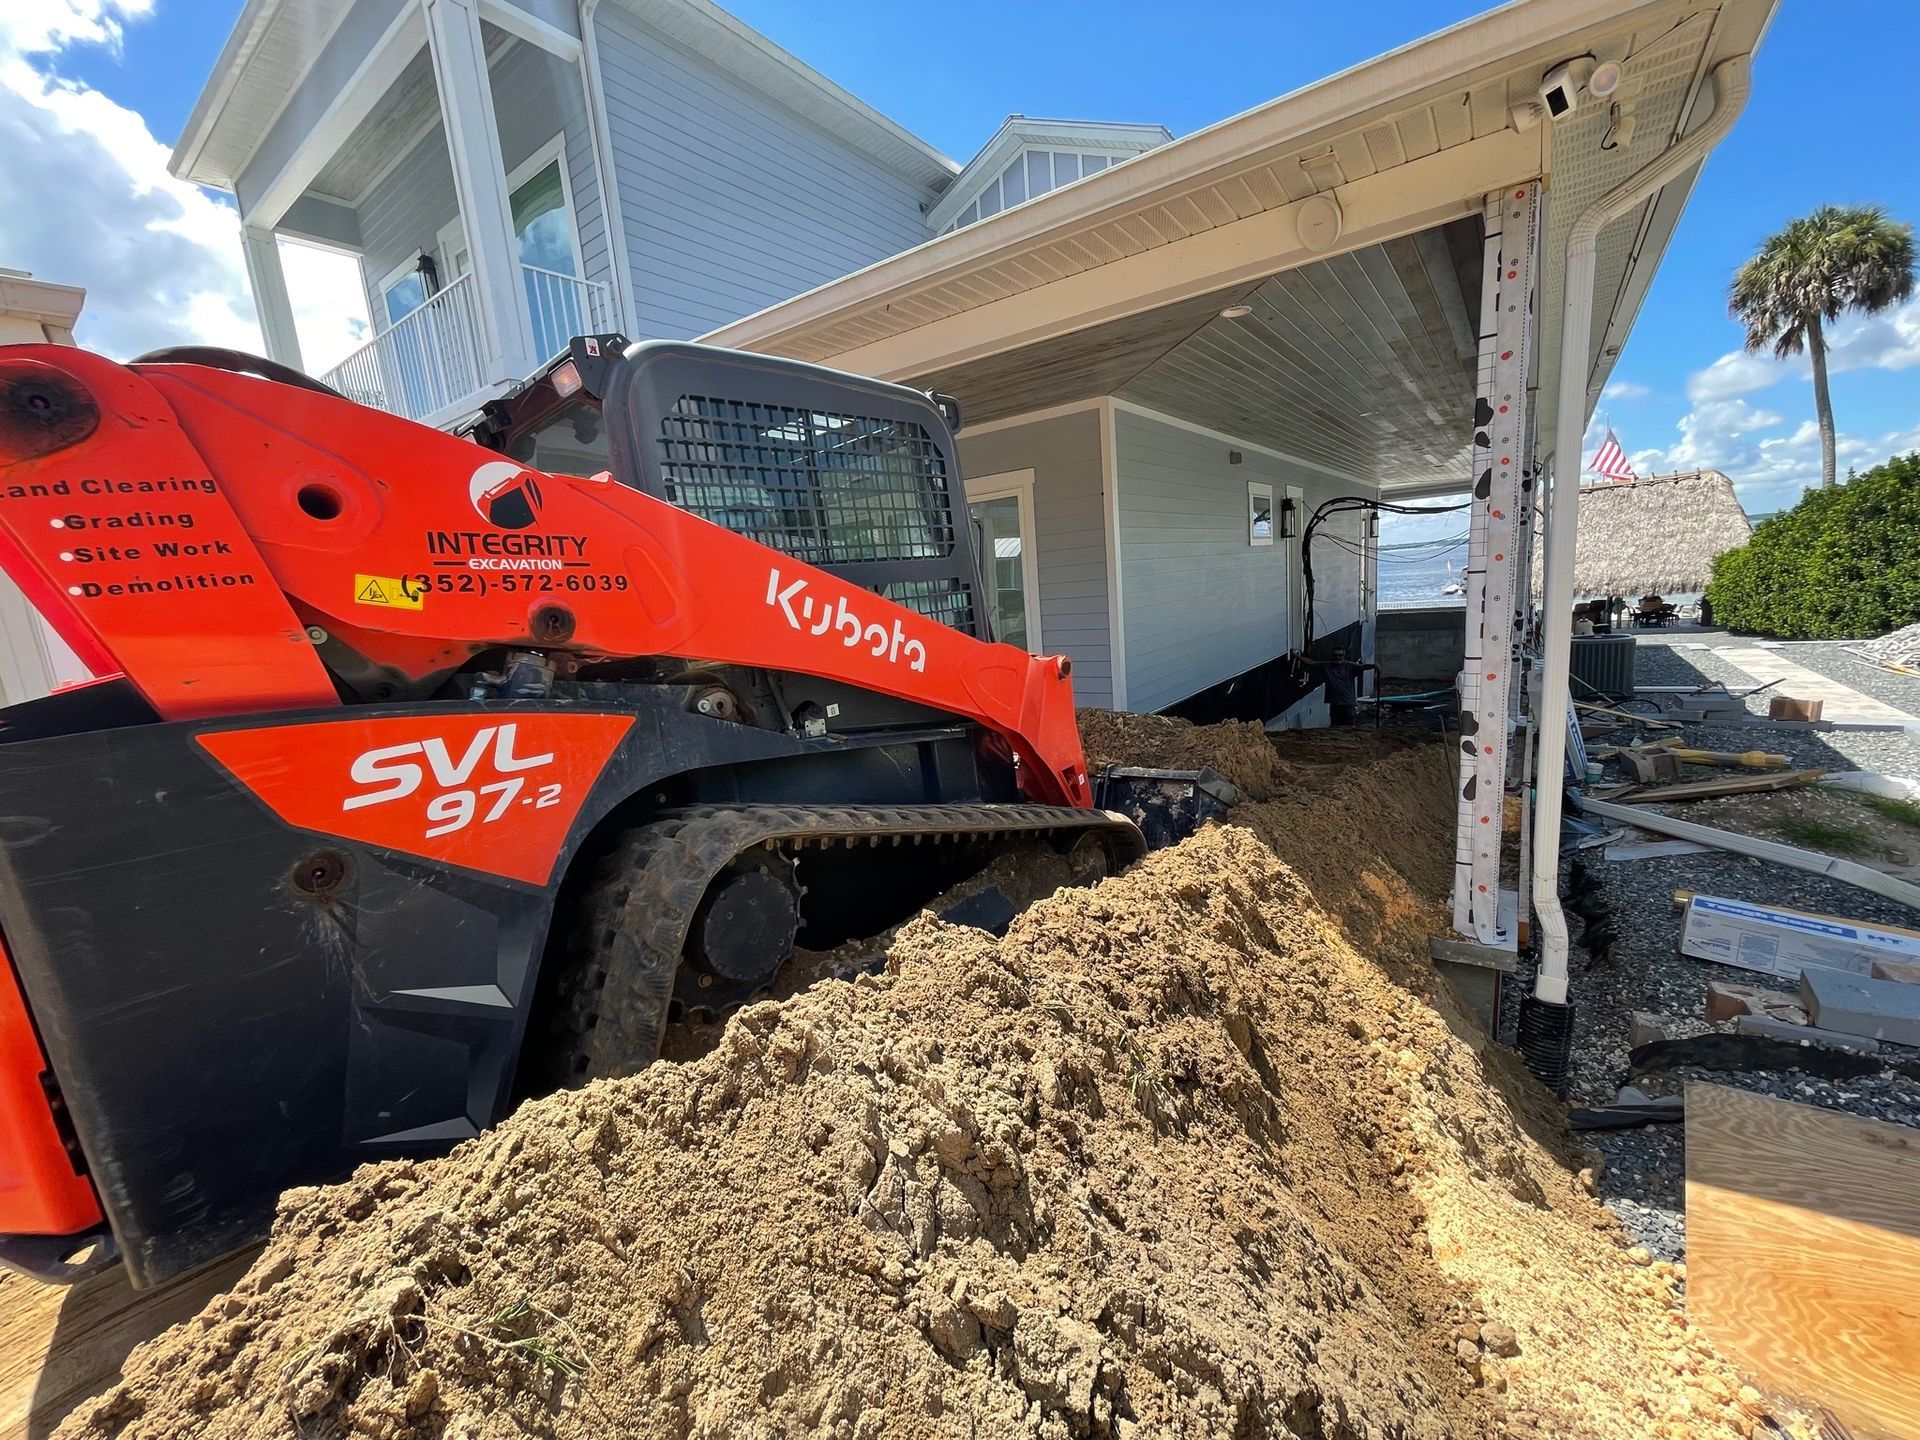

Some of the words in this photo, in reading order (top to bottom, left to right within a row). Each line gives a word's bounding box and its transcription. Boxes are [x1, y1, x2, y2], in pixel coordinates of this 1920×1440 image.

[0, 480, 71, 499] and
[80, 476, 217, 494] Clearing
[64, 511, 195, 530] Grading
[73, 546, 142, 563] Site
[153, 540, 233, 558] Work
[427, 531, 588, 557] INTEGRITY
[468, 558, 563, 571] EXCAVATION
[81, 572, 255, 598] Demolition
[401, 573, 629, 597] (352)-572-6039
[765, 567, 927, 674] Kubota
[342, 723, 554, 811] SVL
[425, 776, 562, 839] 97-2
